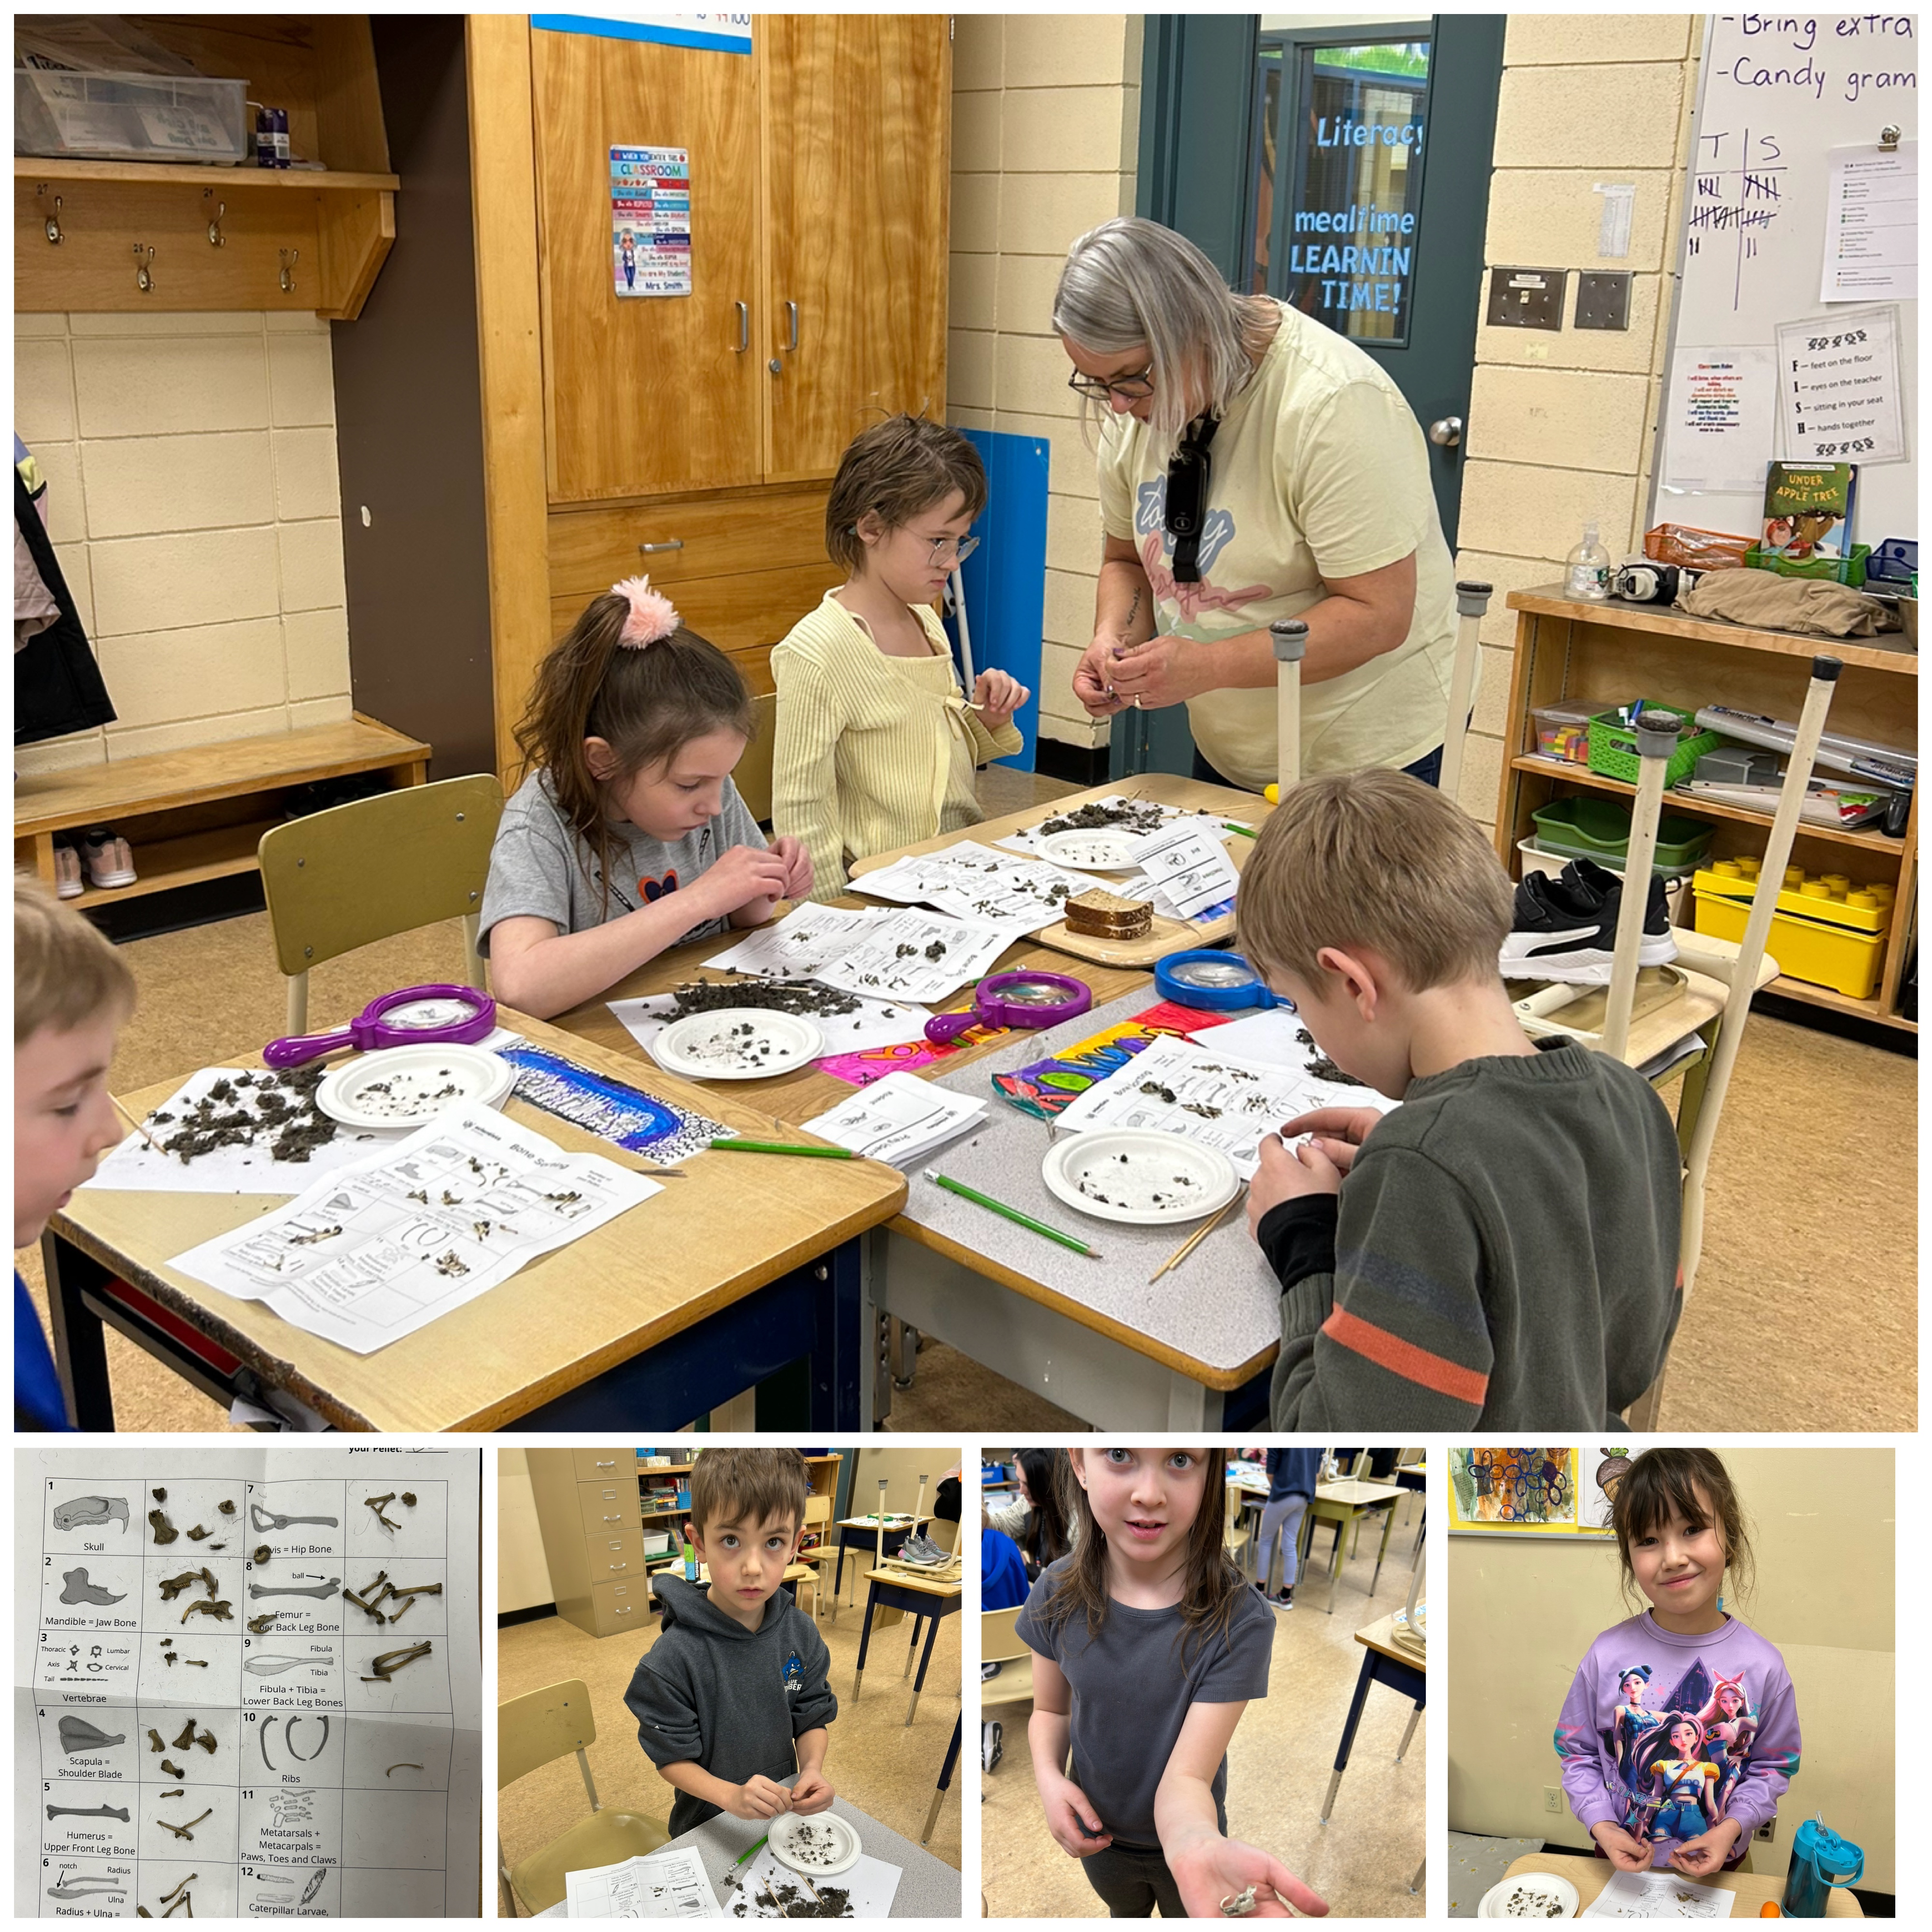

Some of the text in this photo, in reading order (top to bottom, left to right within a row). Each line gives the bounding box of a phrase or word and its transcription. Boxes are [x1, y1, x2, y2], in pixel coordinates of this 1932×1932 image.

[1742, 14, 1817, 50] Bring
[1836, 14, 1913, 39] extra
[1318, 115, 1423, 155] Literacy
[1700, 132, 1729, 158] T
[1760, 135, 1781, 161] S
[621, 164, 682, 176] CLASSROOM
[1295, 205, 1415, 234] mealtime
[1321, 280, 1401, 315] TIME!
[1792, 360, 1798, 371] F
[1794, 381, 1798, 392] I
[1854, 376, 1882, 384] teacher
[1796, 402, 1802, 413] S
[1866, 396, 1883, 405] seat
[1798, 419, 1875, 434] H hands together
[1789, 475, 1824, 486] UNDER
[1776, 486, 1839, 501] APPLE TREE
[509, 1144, 535, 1159] Bone
[48, 1481, 54, 1490] 1
[247, 1485, 254, 1493] 7
[84, 1543, 104, 1551] Skull
[291, 1546, 306, 1554] Hip
[309, 1545, 332, 1553] Bone
[45, 1557, 51, 1565] 2
[275, 1610, 303, 1619] Femur
[45, 1617, 86, 1626] Mandible
[95, 1618, 112, 1628] Jaw
[276, 1623, 297, 1632] Back
[299, 1623, 314, 1634] Leg
[317, 1623, 340, 1632] Bone
[41, 1634, 47, 1642] 3
[244, 1639, 251, 1648] 9
[260, 1685, 286, 1694] Fibula
[296, 1686, 318, 1694] Tibia
[63, 1694, 107, 1703] Vertebrae
[243, 1697, 343, 1709] Lower Back Leg Bones
[243, 1713, 256, 1721] 10
[70, 1757, 102, 1767] Scapula
[58, 1769, 96, 1778] Shoulder
[282, 1775, 300, 1783] Ribs
[67, 1832, 105, 1841] Humerus
[261, 1828, 312, 1838] Metatarsals
[44, 1843, 70, 1852] Upper
[97, 1846, 111, 1855] Leg
[114, 1847, 135, 1855] Bone
[259, 1841, 313, 1851] Metacarpals
[43, 1859, 49, 1867] 6
[241, 1852, 337, 1864] Paws, Toes and Claws
[241, 1867, 254, 1876] 12
[56, 1908, 84, 1917] Radius
[94, 1909, 113, 1918] Ulna
[249, 1904, 329, 1917] Caterpillar Larvae,
